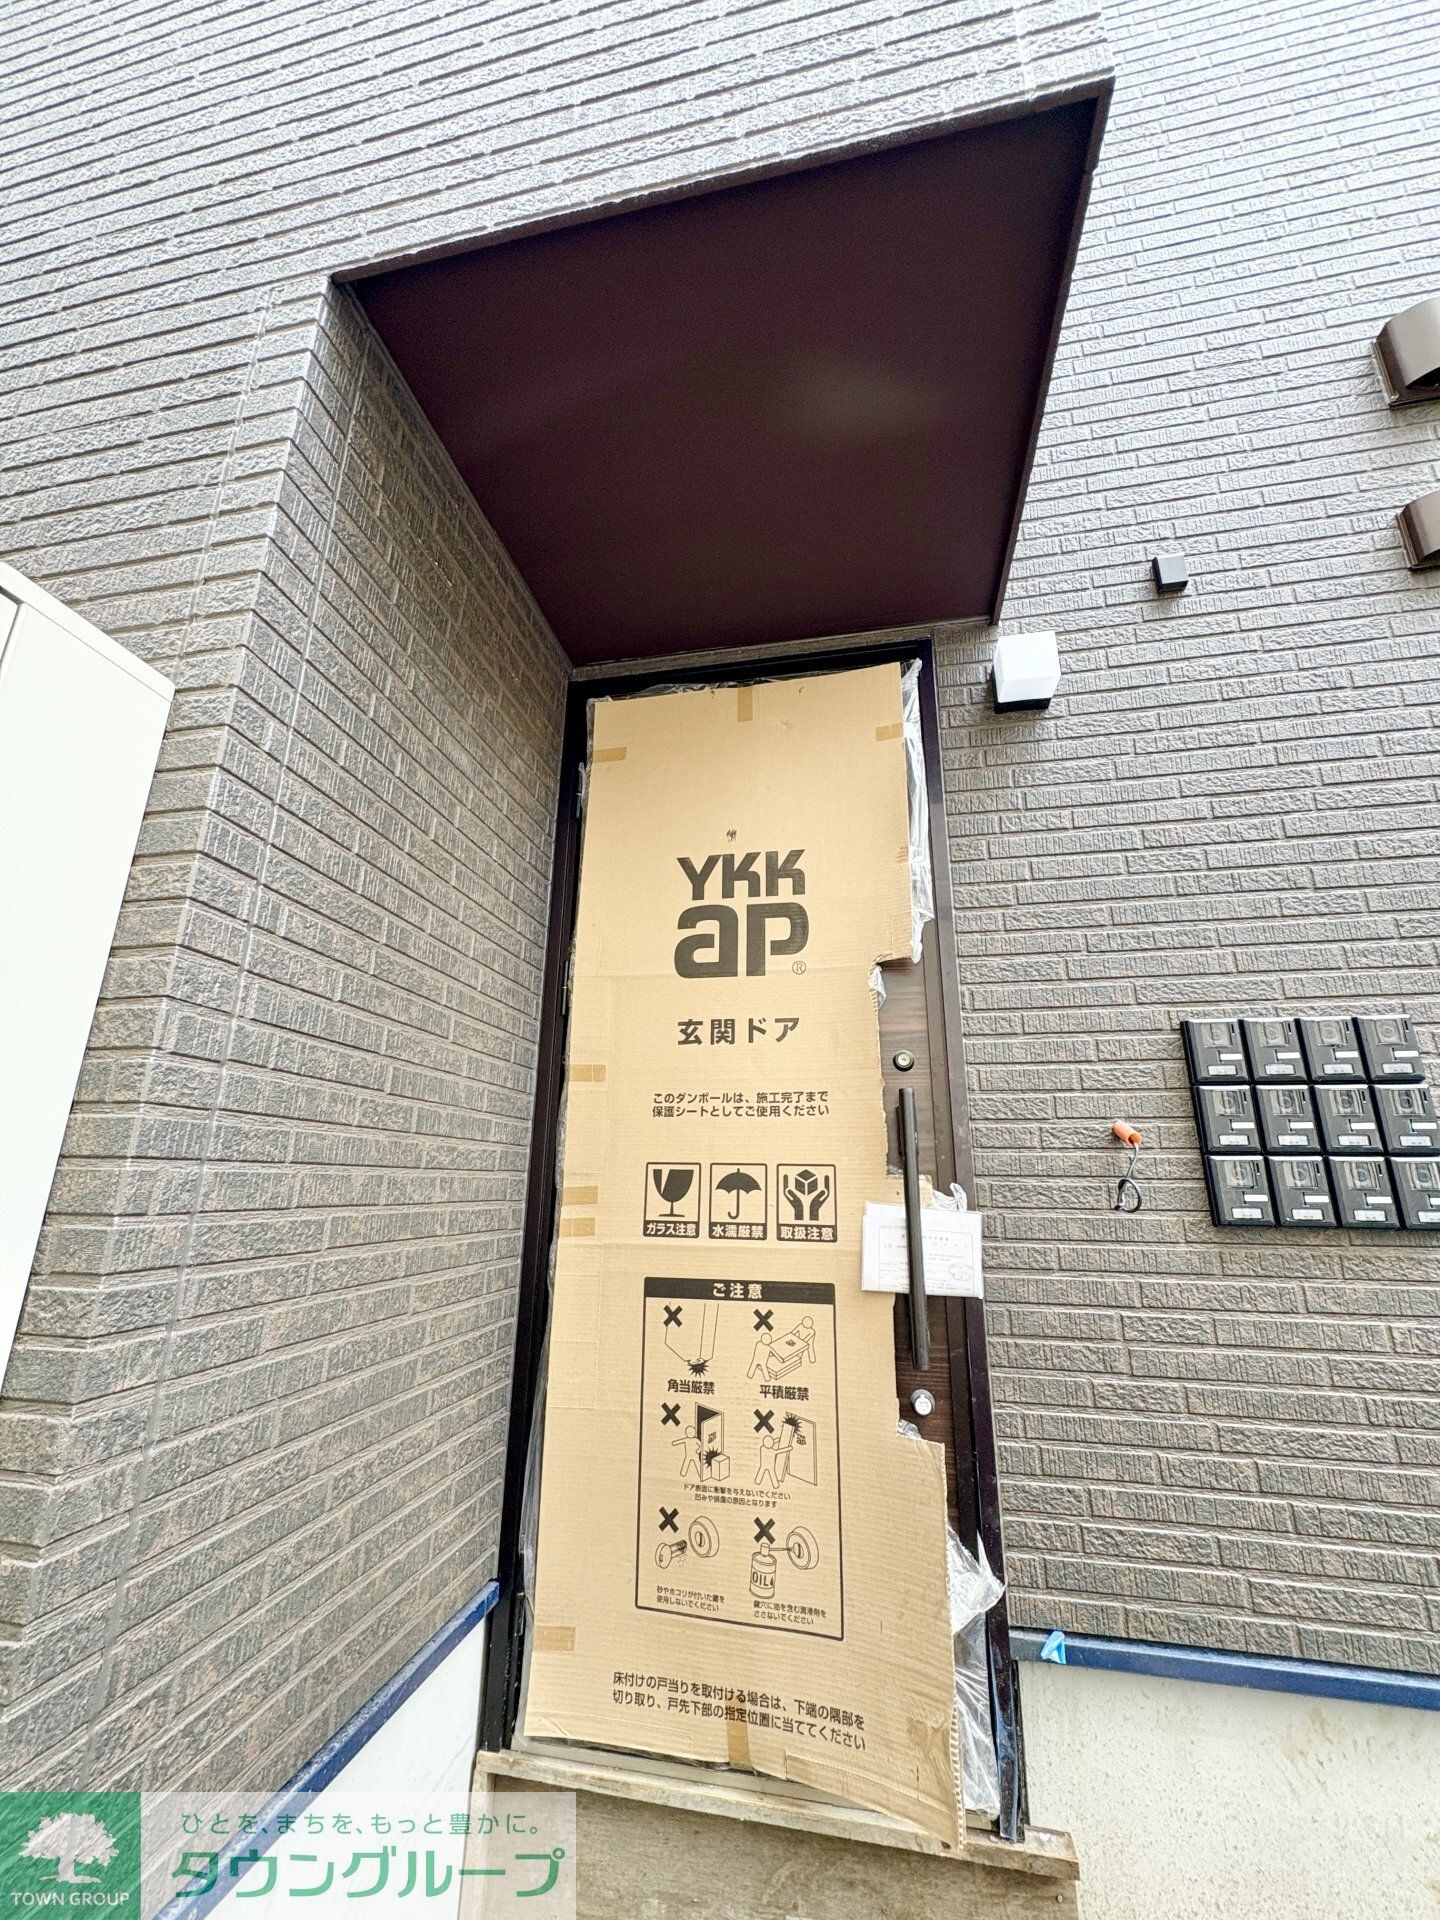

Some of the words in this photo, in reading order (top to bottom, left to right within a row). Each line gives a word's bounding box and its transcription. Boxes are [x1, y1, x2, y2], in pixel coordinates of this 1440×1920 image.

[676, 849, 806, 901] YKK
[677, 1017, 800, 1046] 玄関ドア
[653, 1091, 829, 1104] このダンボールは、施工完了まで
[652, 1104, 830, 1118] 保護シートとしてご使用ください
[646, 1222, 697, 1236] ガラス注意
[712, 1225, 764, 1239] 水濡厳禁
[780, 1227, 834, 1241] 取扱注意
[712, 1282, 763, 1299] ご注意
[667, 1379, 715, 1395] 角当厳禁
[759, 1384, 810, 1401] 平積厳禁
[752, 1571, 769, 1587] OIL
[656, 1594, 720, 1612] 使用しないでください
[753, 1610, 814, 1625] ささないでください
[613, 1671, 865, 1731] 床付けの戸当りを取付ける場合は、下端の隅部を
[612, 1689, 867, 1750] 切り取り、戸先下部の指定位置に当ててください
